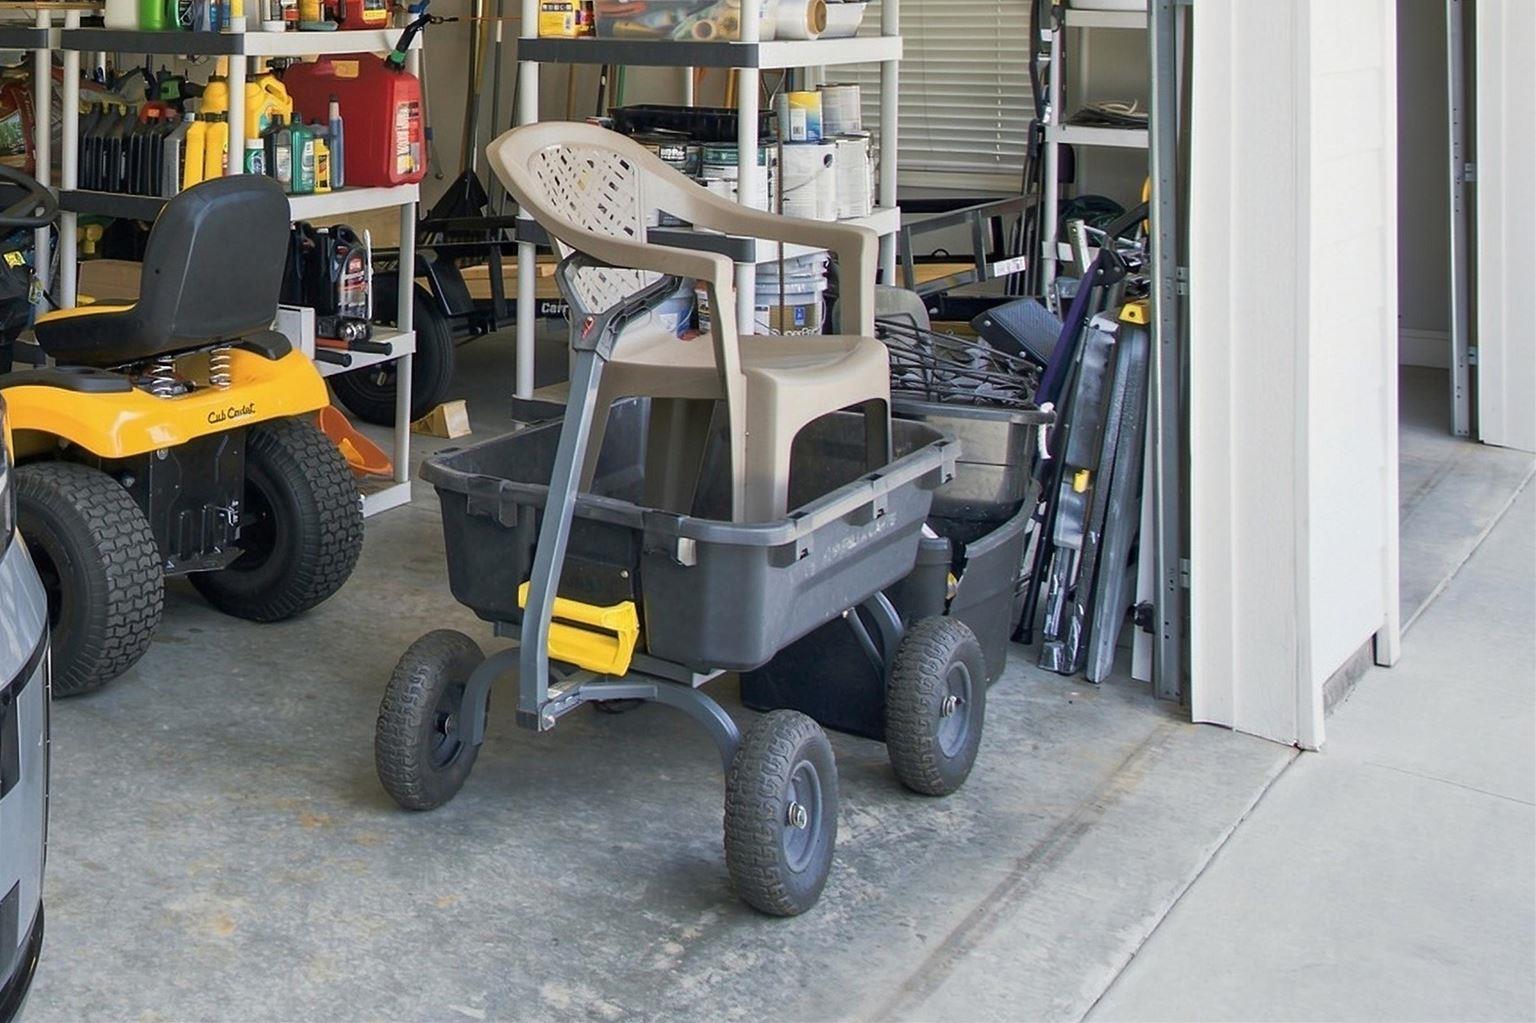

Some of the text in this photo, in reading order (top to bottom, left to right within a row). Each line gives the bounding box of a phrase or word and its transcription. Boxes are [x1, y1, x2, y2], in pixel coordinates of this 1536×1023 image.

[541, 302, 569, 314] Carr
[207, 402, 256, 424] Cub Cadet
